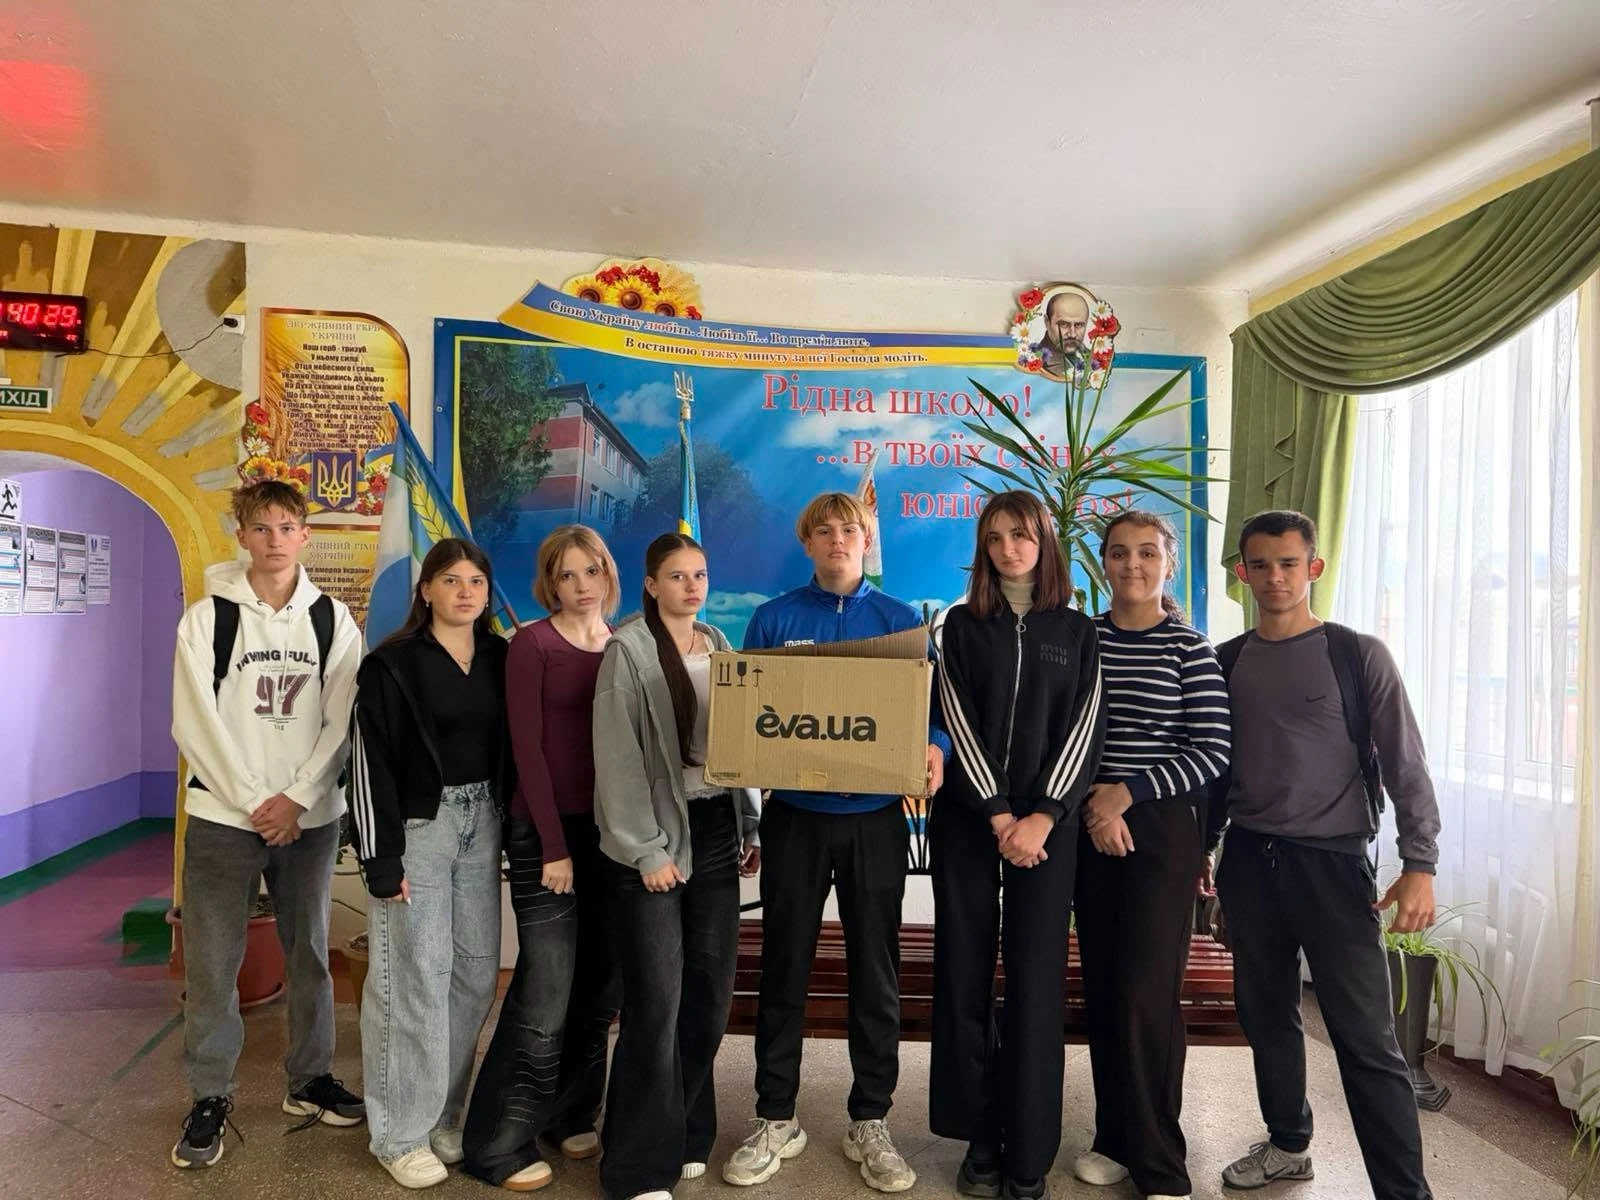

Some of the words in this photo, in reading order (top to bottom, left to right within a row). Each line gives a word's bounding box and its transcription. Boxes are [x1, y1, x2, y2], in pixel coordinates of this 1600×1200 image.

[550, 300, 587, 318] Свою
[590, 308, 643, 330] Україну
[625, 337, 635, 348] В
[743, 352, 788, 364] минуту
[792, 353, 806, 362] за
[830, 353, 880, 363] Господа
[884, 352, 928, 362] моліть.
[763, 374, 877, 417] Рідна
[888, 385, 1031, 417] школо!
[885, 432, 986, 468] твоїх
[254, 674, 312, 716] 97
